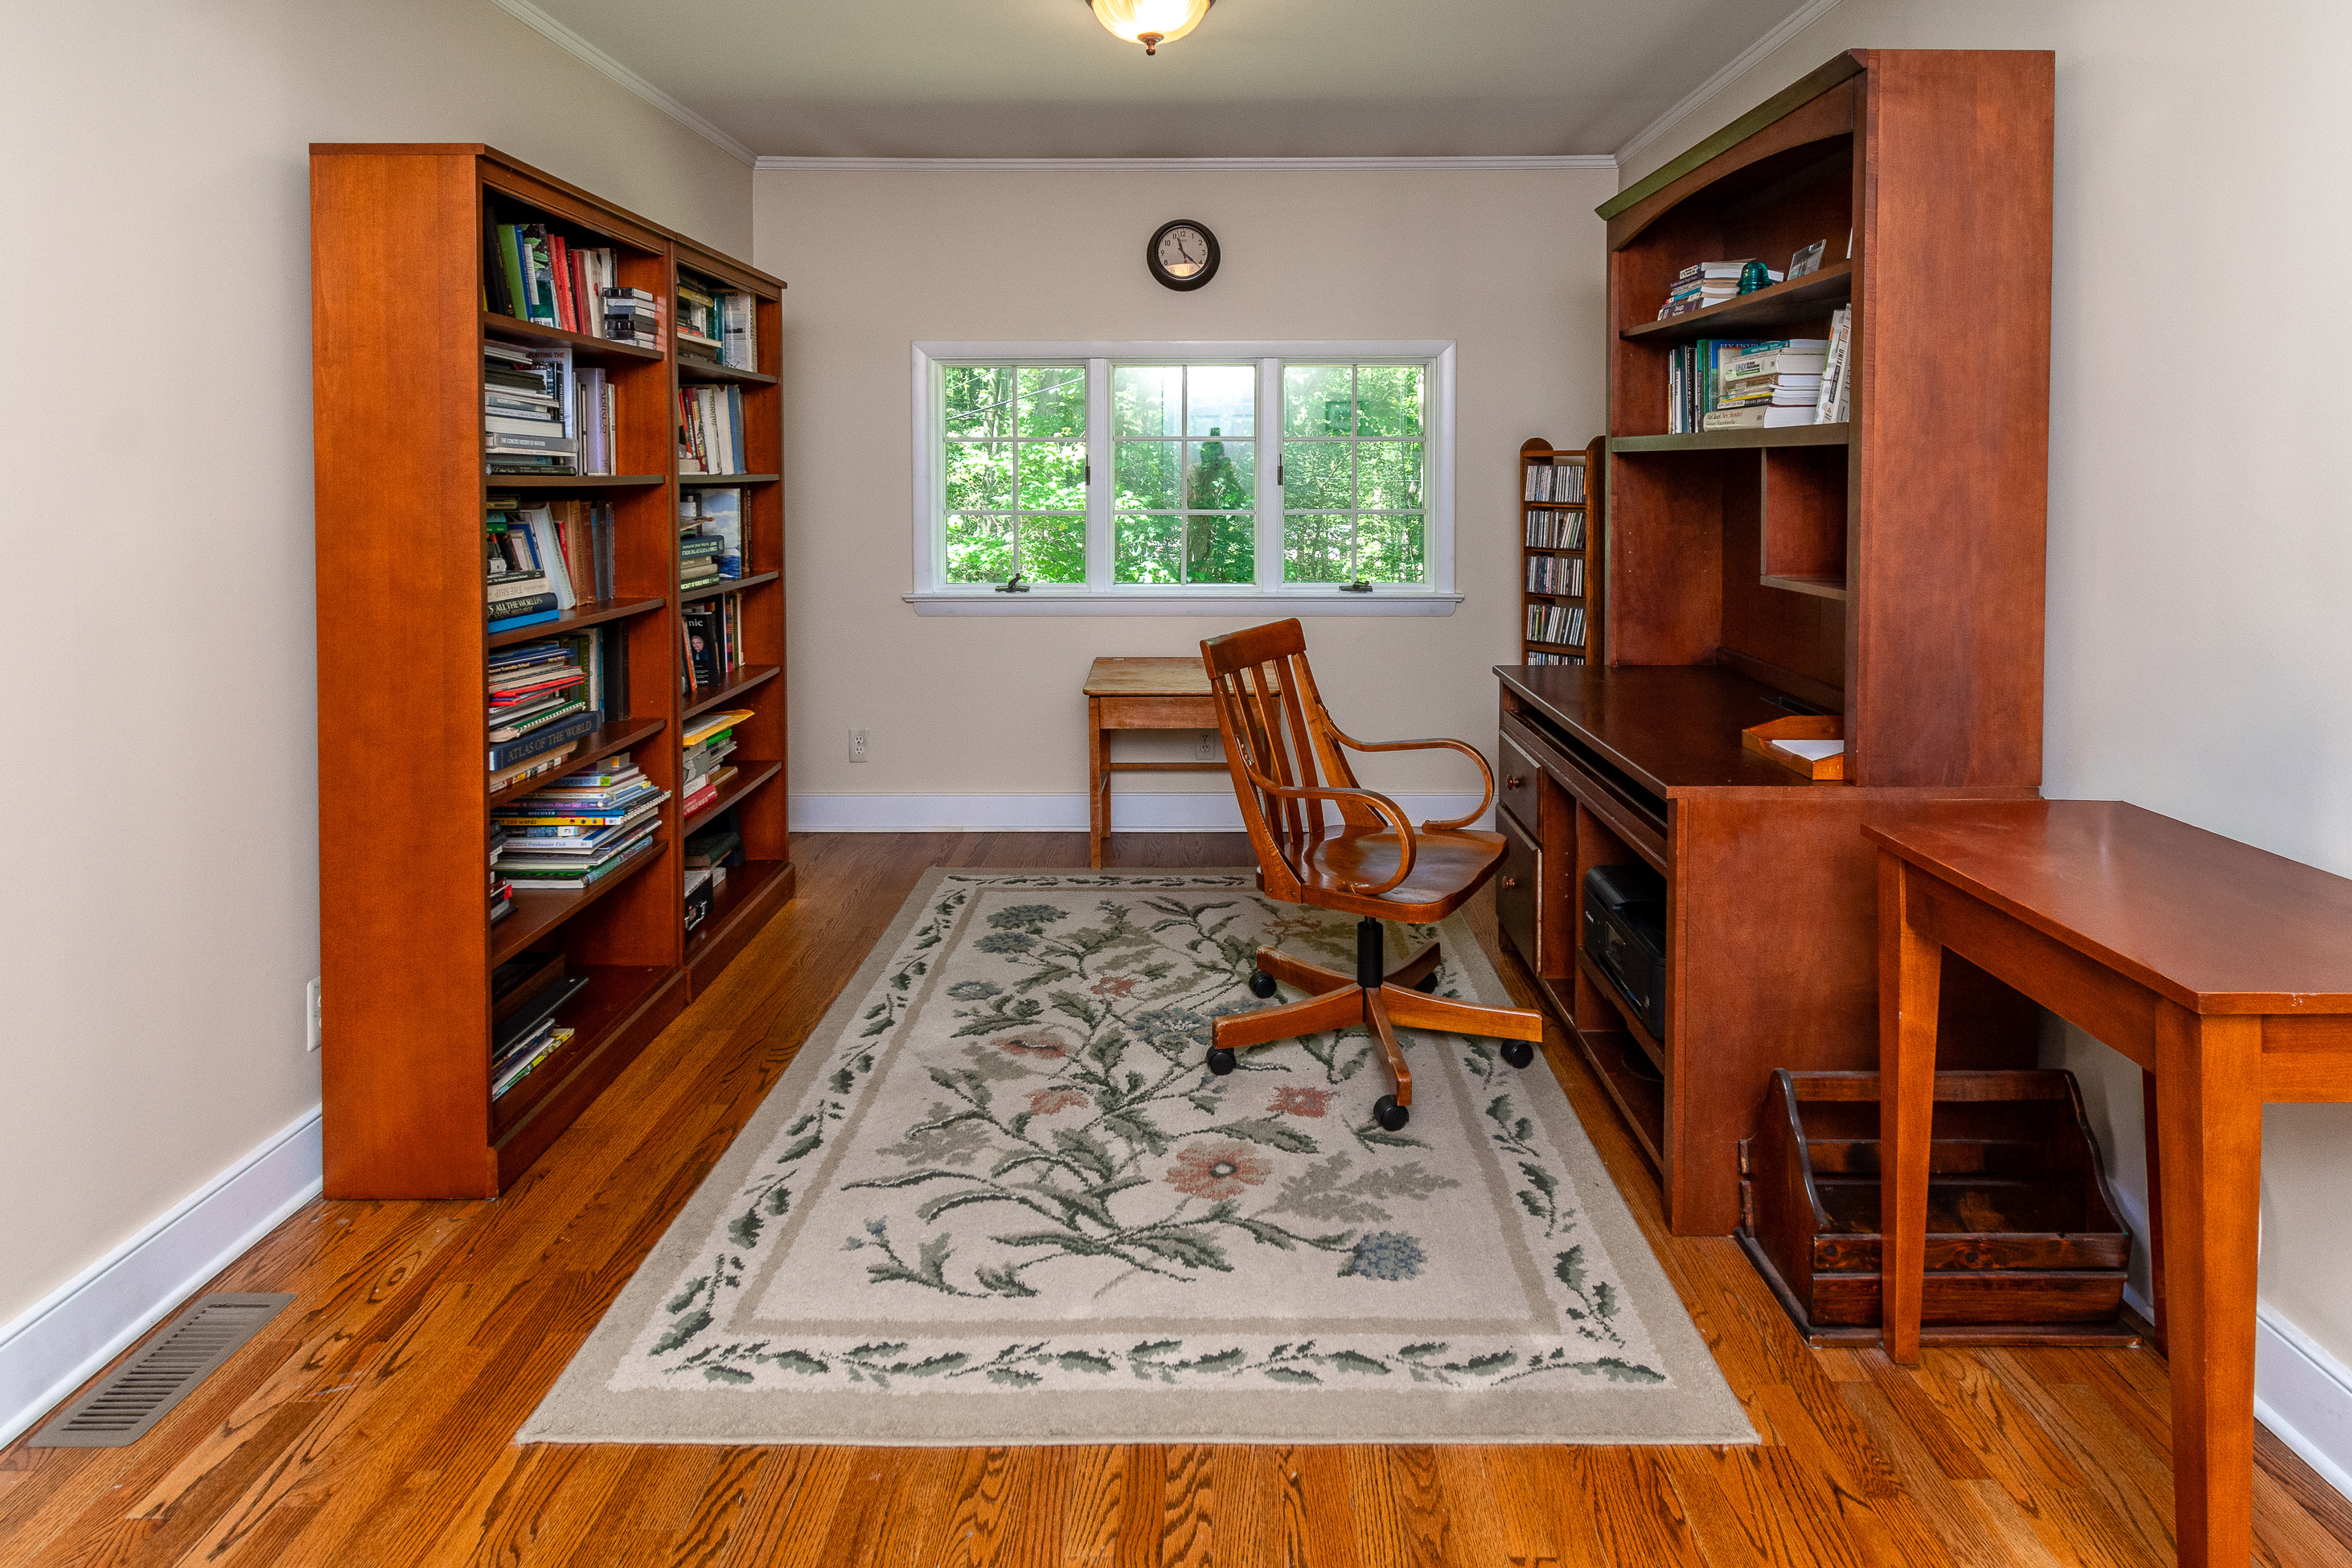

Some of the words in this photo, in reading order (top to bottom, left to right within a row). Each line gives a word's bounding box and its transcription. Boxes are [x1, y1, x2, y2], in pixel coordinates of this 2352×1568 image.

[1836, 348, 1845, 366] UNIX
[1735, 363, 1747, 372] UNIX
[495, 588, 511, 598] SHIP
[495, 602, 507, 612] ALL
[506, 601, 519, 610] THE
[518, 597, 543, 608] WORLD'S
[507, 743, 534, 761] ATLAS
[535, 739, 547, 750] OF
[548, 731, 564, 745] THE
[566, 720, 592, 737] WORLD
